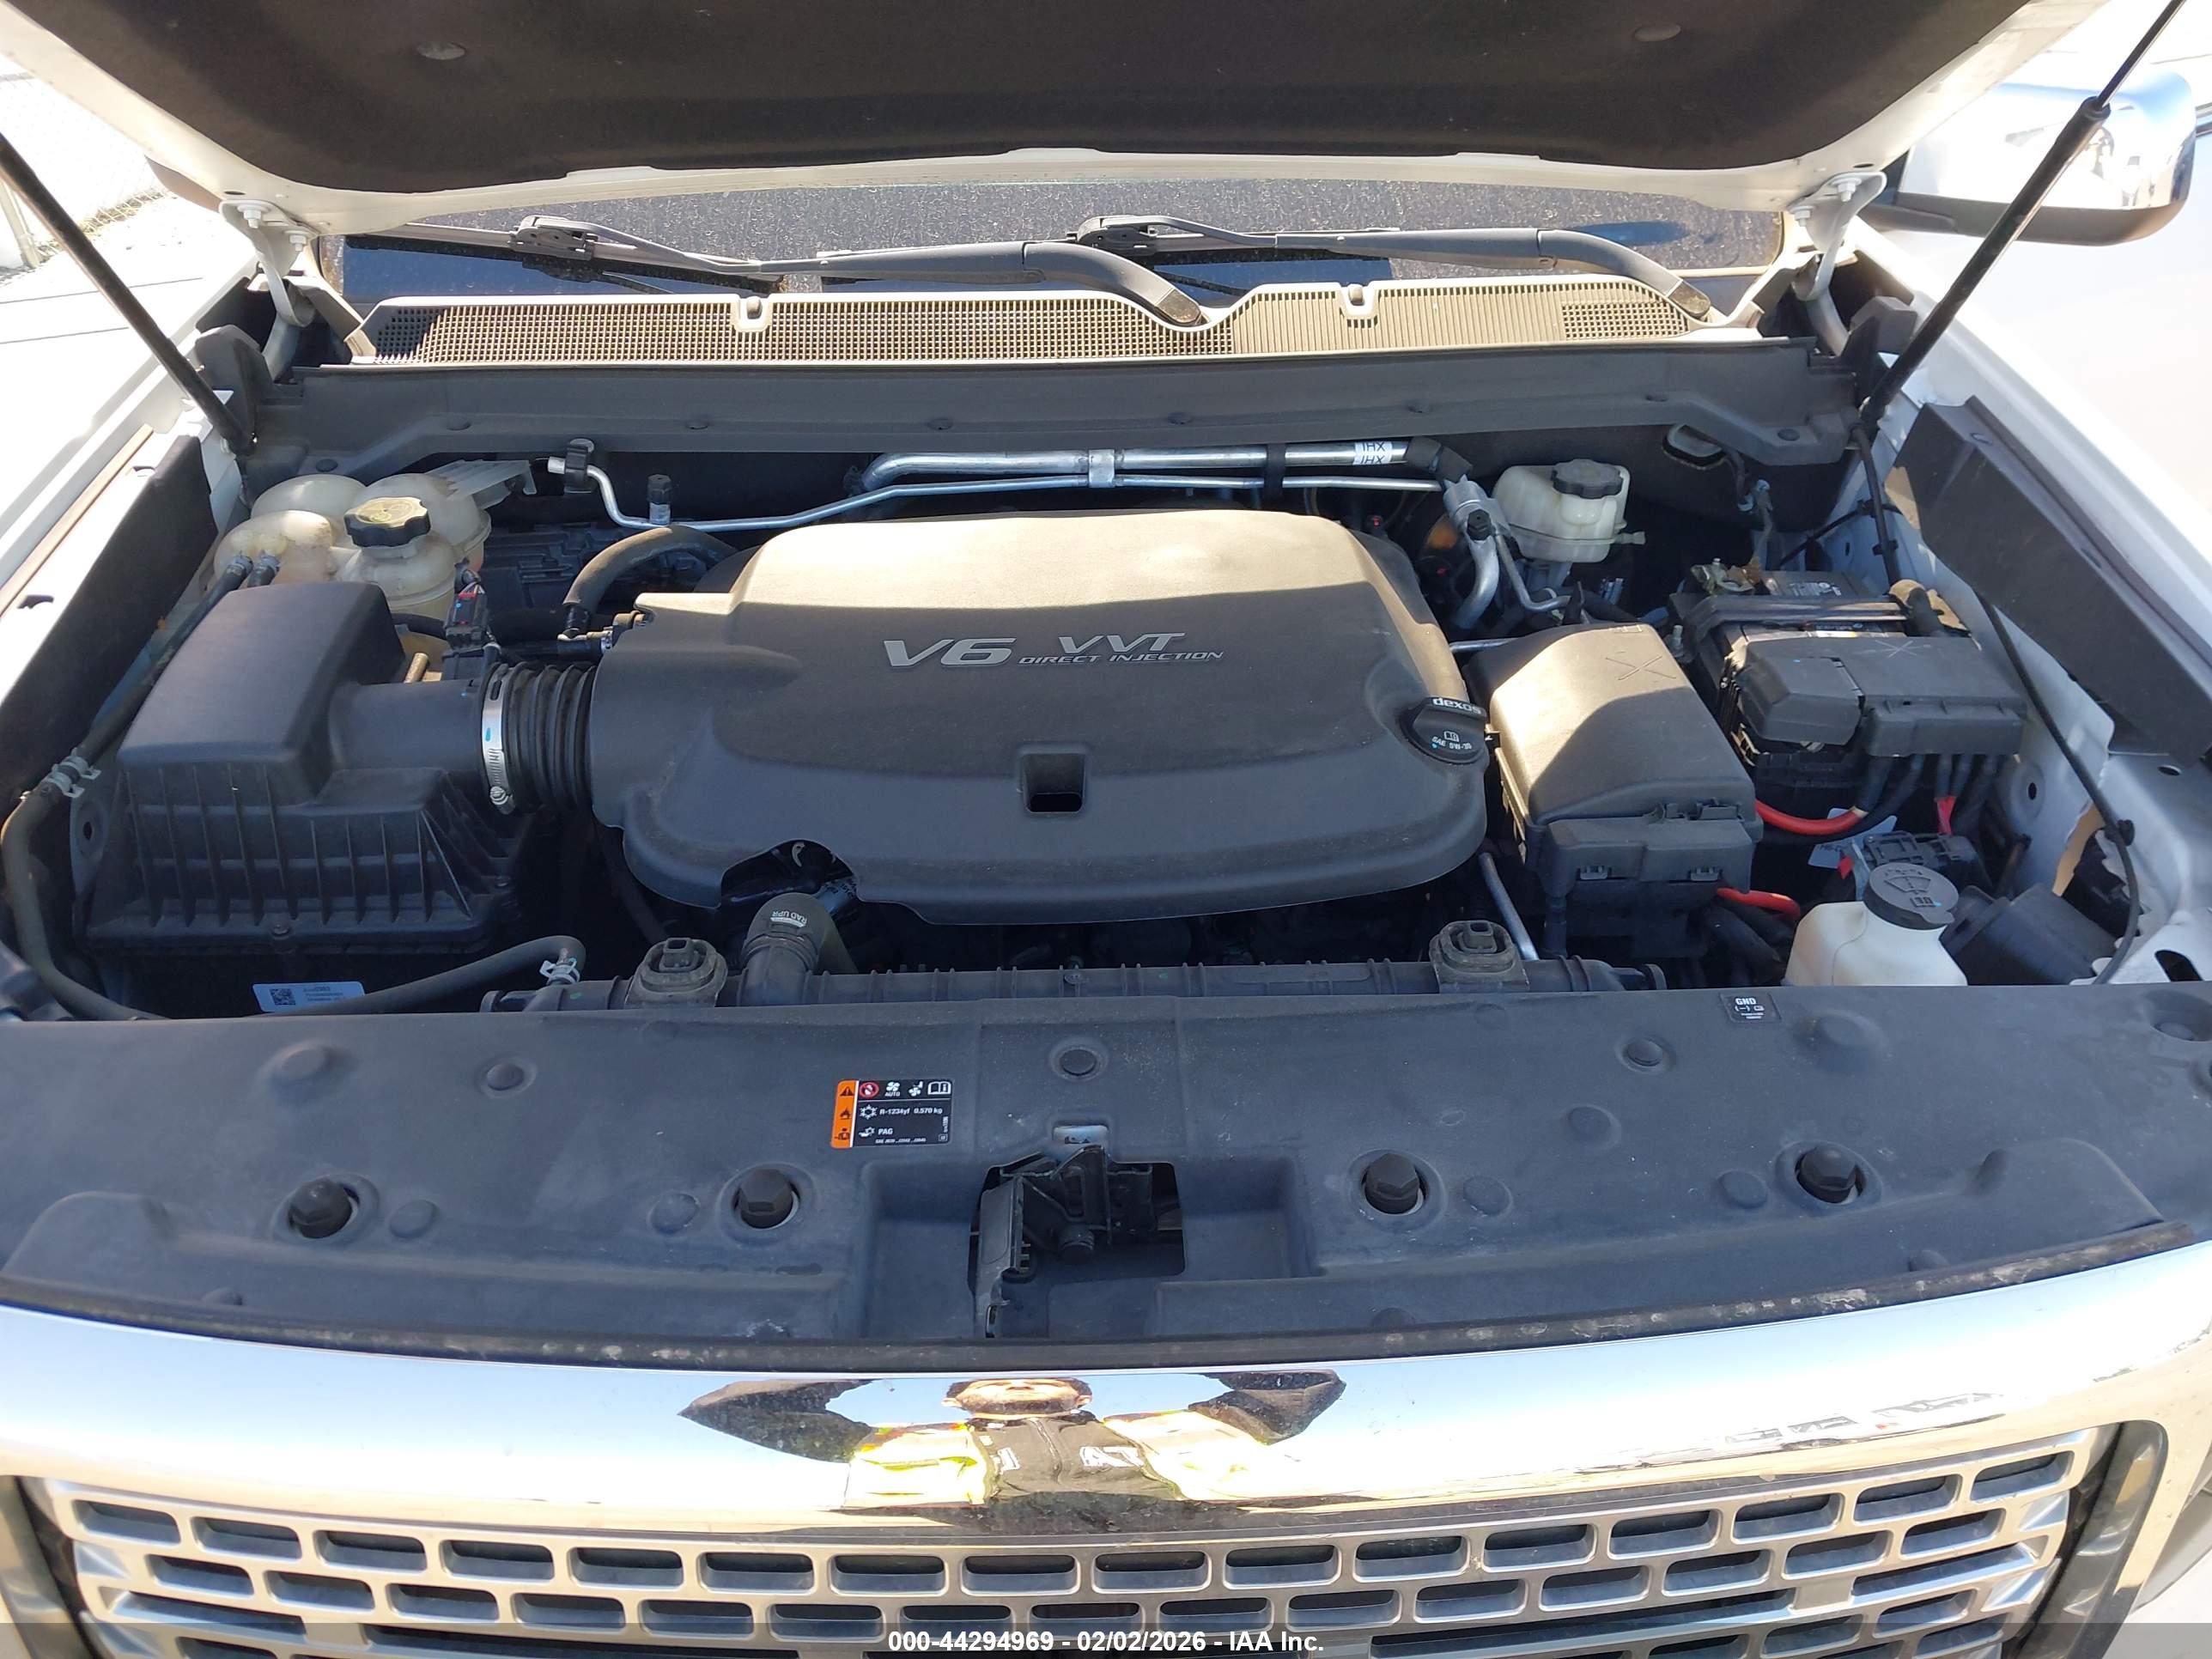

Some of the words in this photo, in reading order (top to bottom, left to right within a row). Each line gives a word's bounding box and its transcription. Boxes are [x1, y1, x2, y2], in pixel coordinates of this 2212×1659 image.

[1363, 441, 1385, 452] IHX
[883, 638, 1017, 666] V6
[1058, 633, 1186, 654] VVT
[1018, 655, 1101, 665] DIRECT
[1109, 651, 1224, 663] INJECTION
[1432, 697, 1482, 714] dexos
[791, 912, 807, 924] RAD
